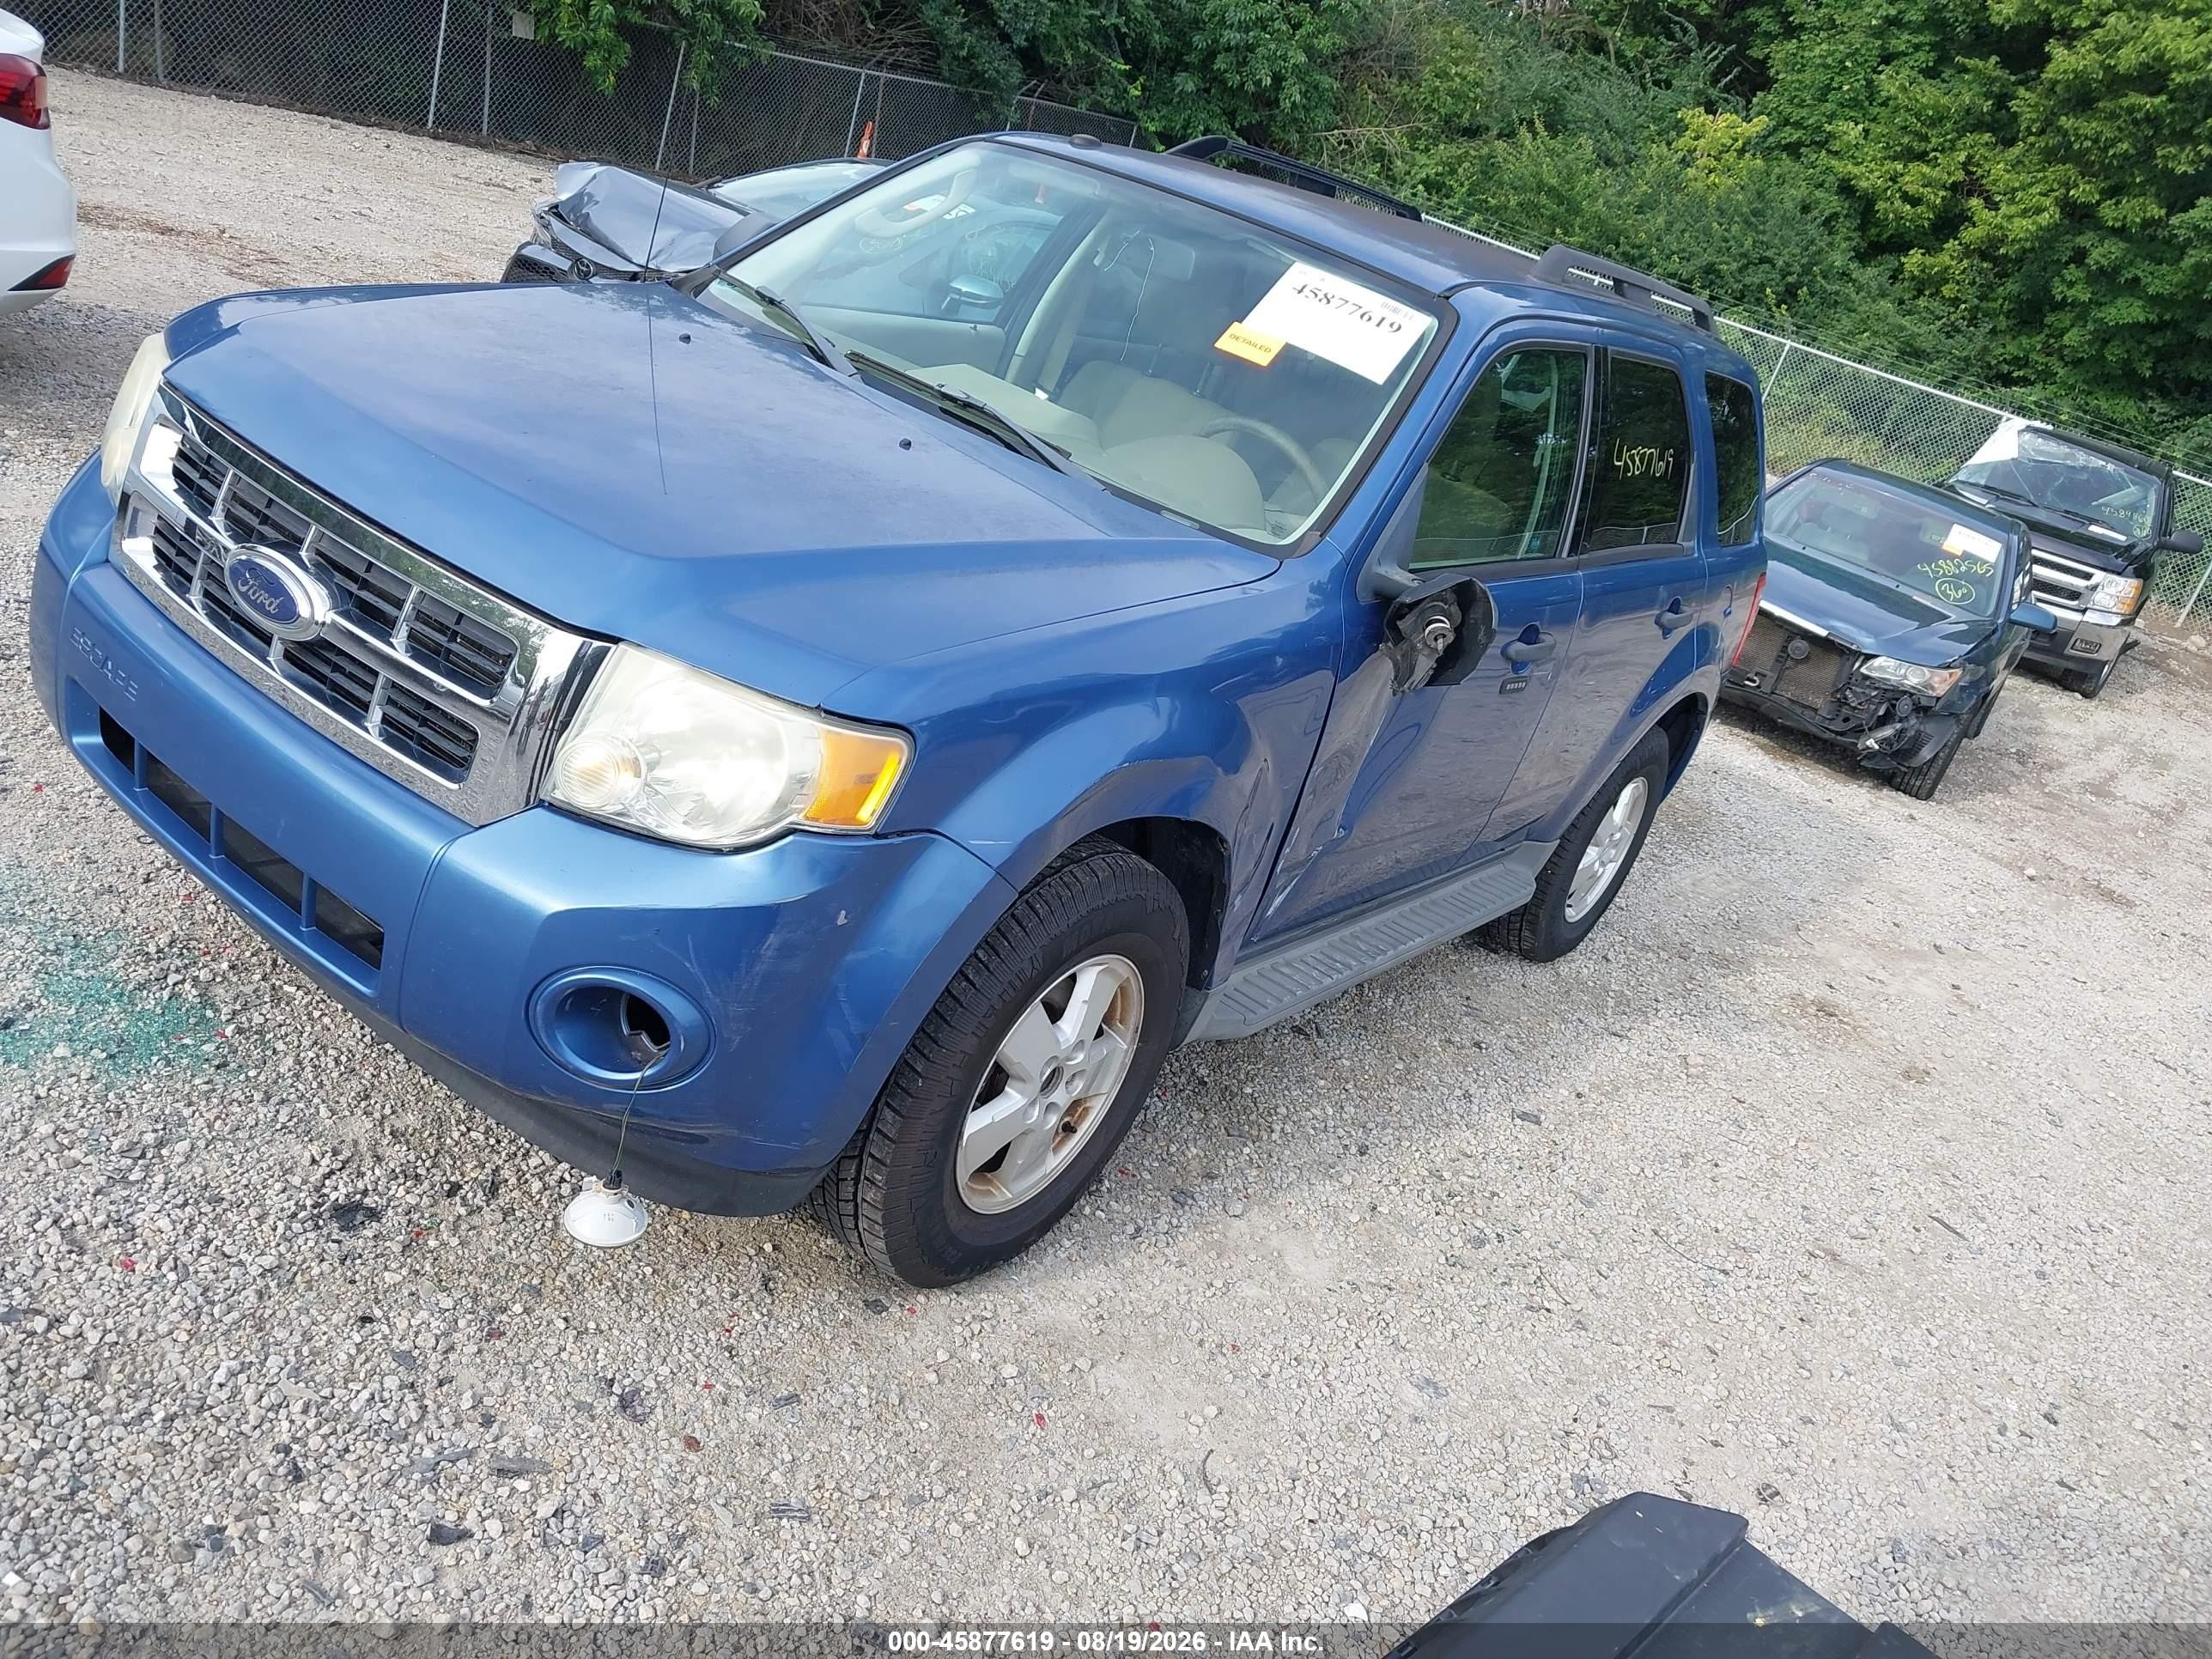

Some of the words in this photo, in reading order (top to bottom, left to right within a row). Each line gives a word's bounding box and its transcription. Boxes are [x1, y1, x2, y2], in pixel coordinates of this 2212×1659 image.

[1291, 283, 1402, 333] 45877619
[1228, 332, 1273, 354] DETAILED
[1613, 437, 1674, 481] 45877619
[237, 567, 285, 614] Ford
[1917, 558, 1994, 579] 45882565
[69, 626, 138, 702] ESCAPE
